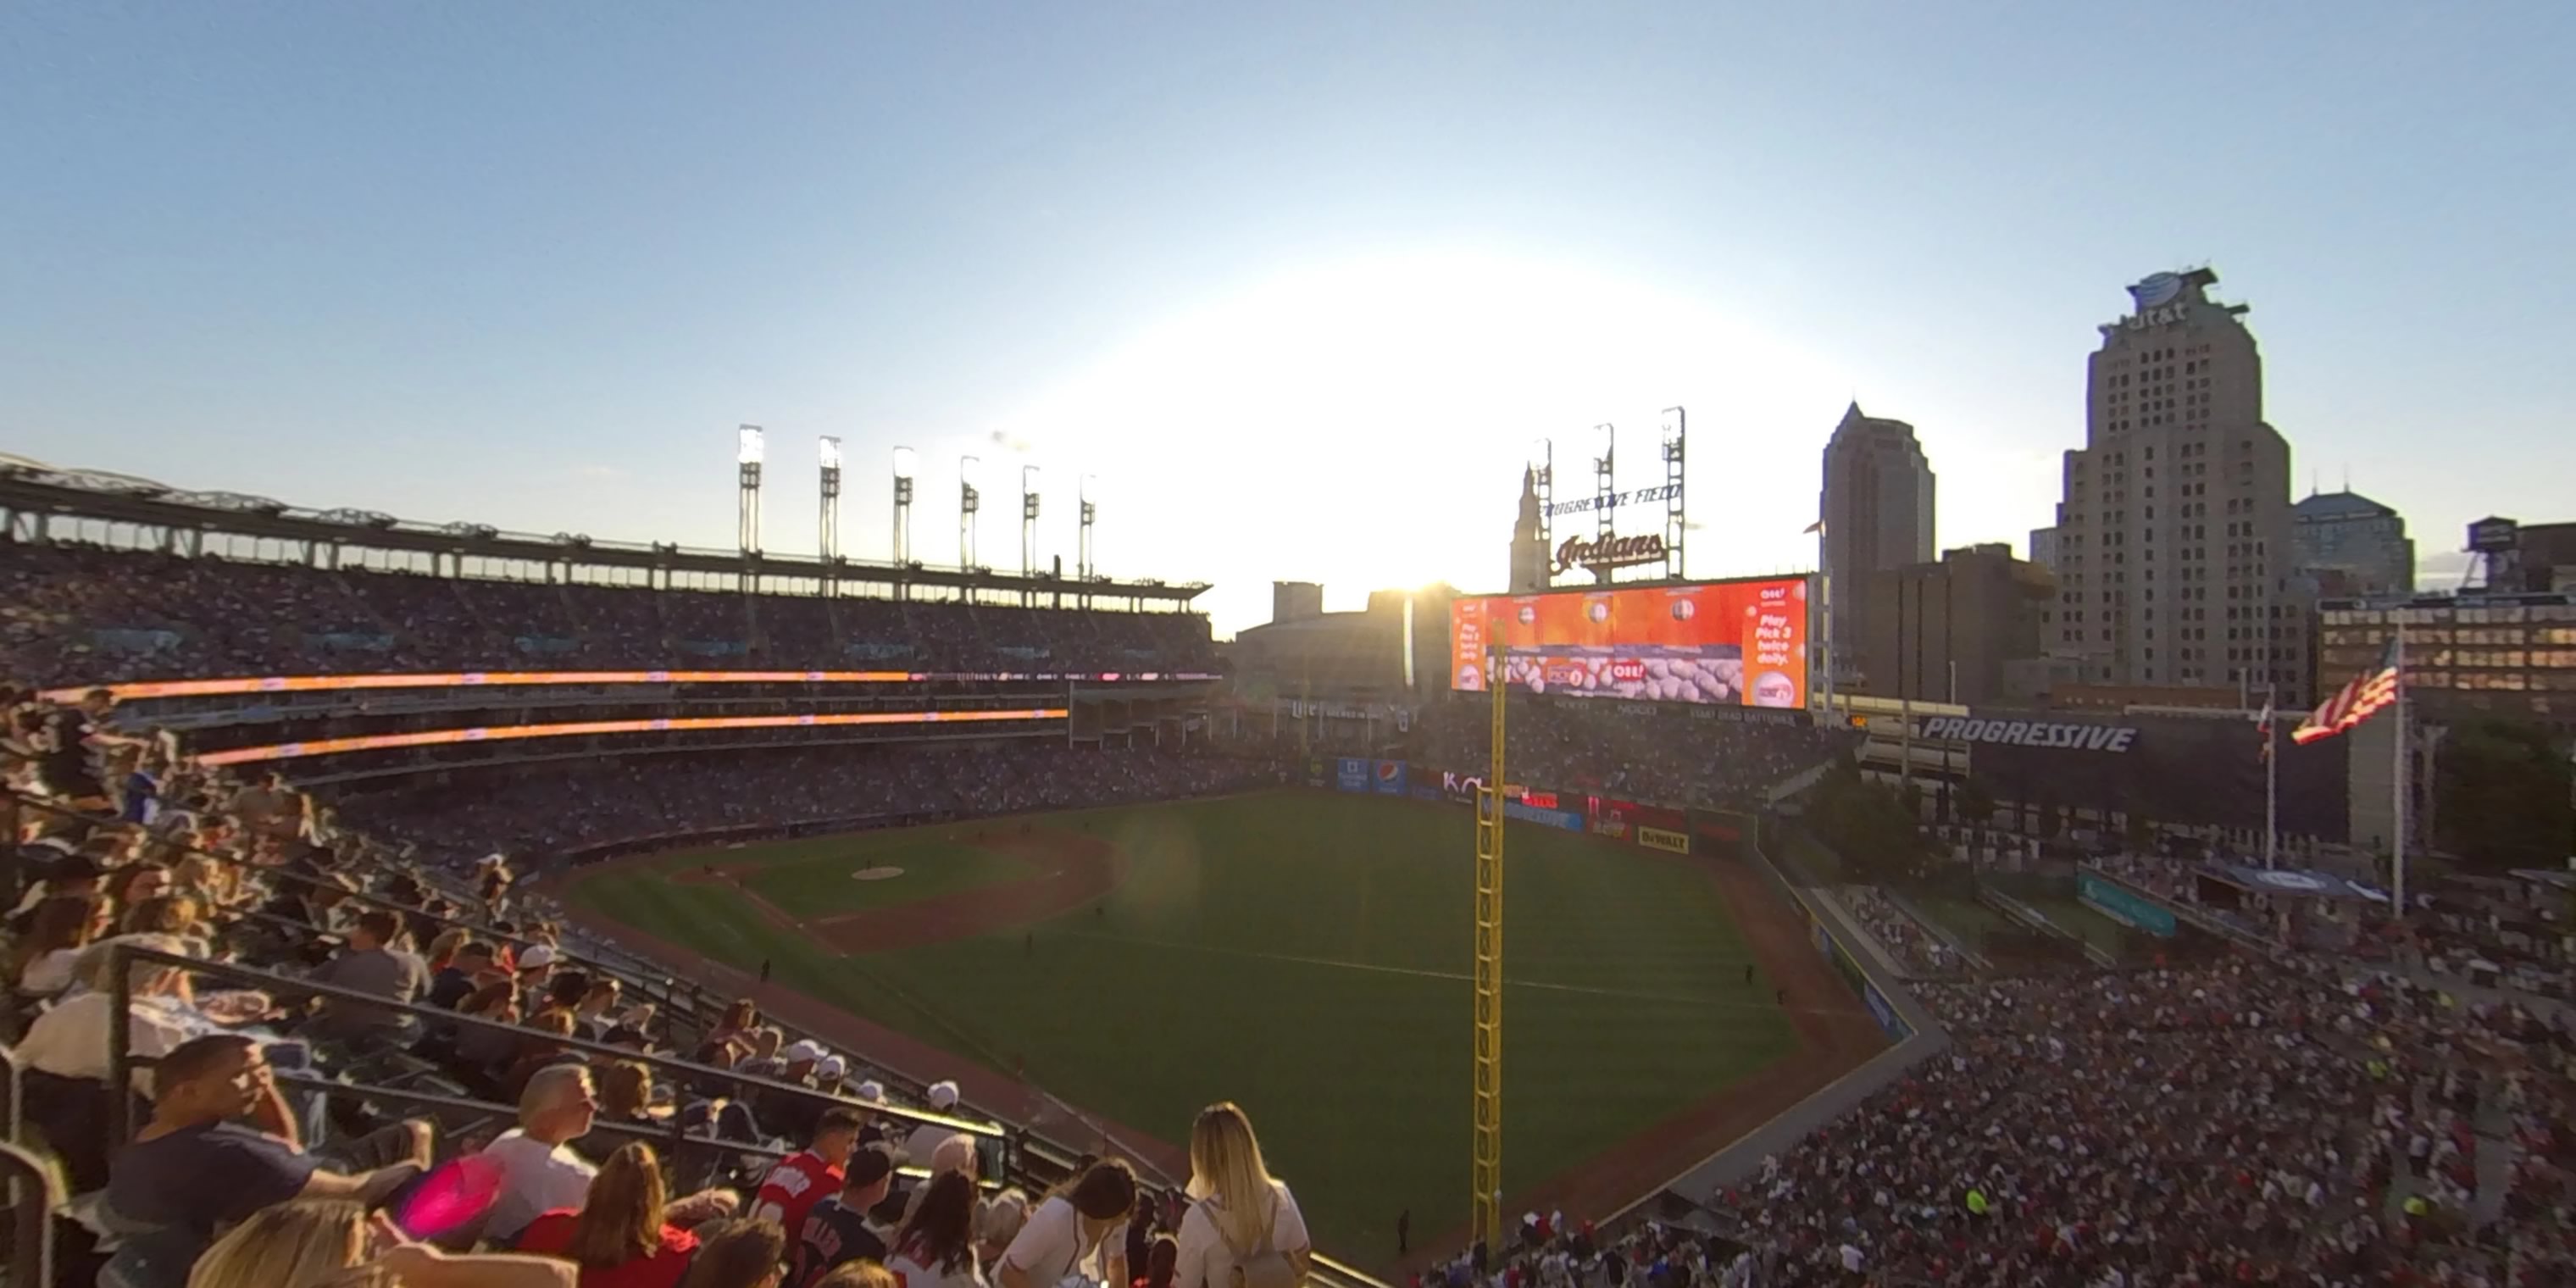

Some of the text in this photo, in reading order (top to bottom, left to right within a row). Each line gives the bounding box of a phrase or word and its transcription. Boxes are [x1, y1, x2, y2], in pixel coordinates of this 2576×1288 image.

[1634, 484, 1683, 504] FIELD
[1550, 530, 1667, 575] Indians
[1760, 614, 1787, 627] Play
[1755, 626, 1792, 639] Pick 3
[1757, 640, 1790, 652] twice
[1922, 716, 2138, 753] PROGRESSIVE
